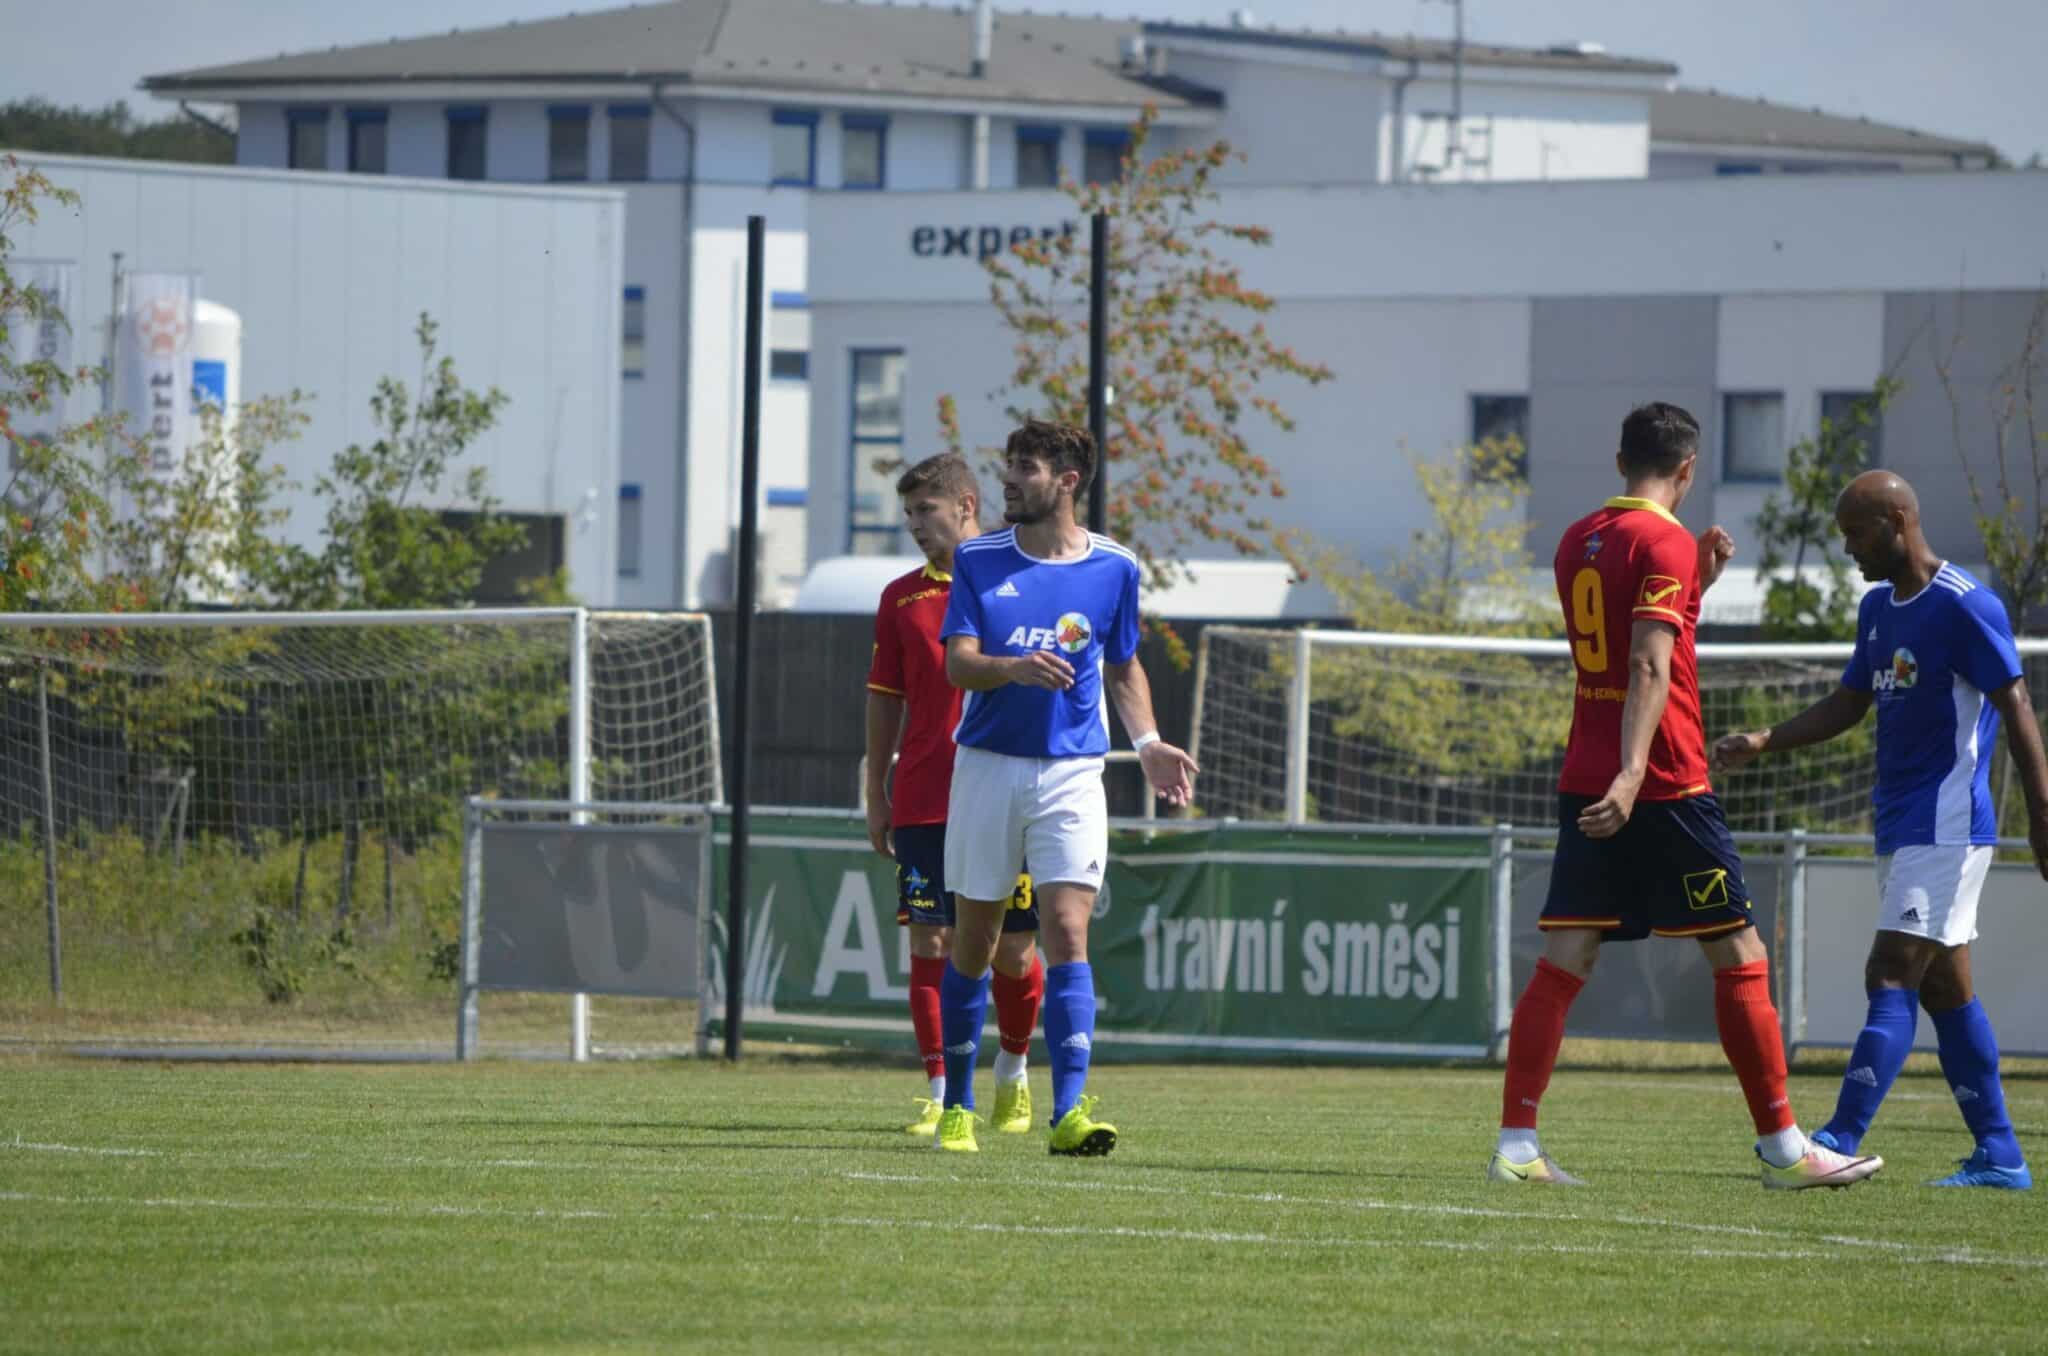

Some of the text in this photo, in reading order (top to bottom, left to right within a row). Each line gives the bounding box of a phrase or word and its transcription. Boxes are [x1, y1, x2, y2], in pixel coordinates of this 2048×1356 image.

[1572, 567, 1608, 672] 9
[1140, 899, 1288, 993] travní
[1300, 902, 1462, 1000] směsi
